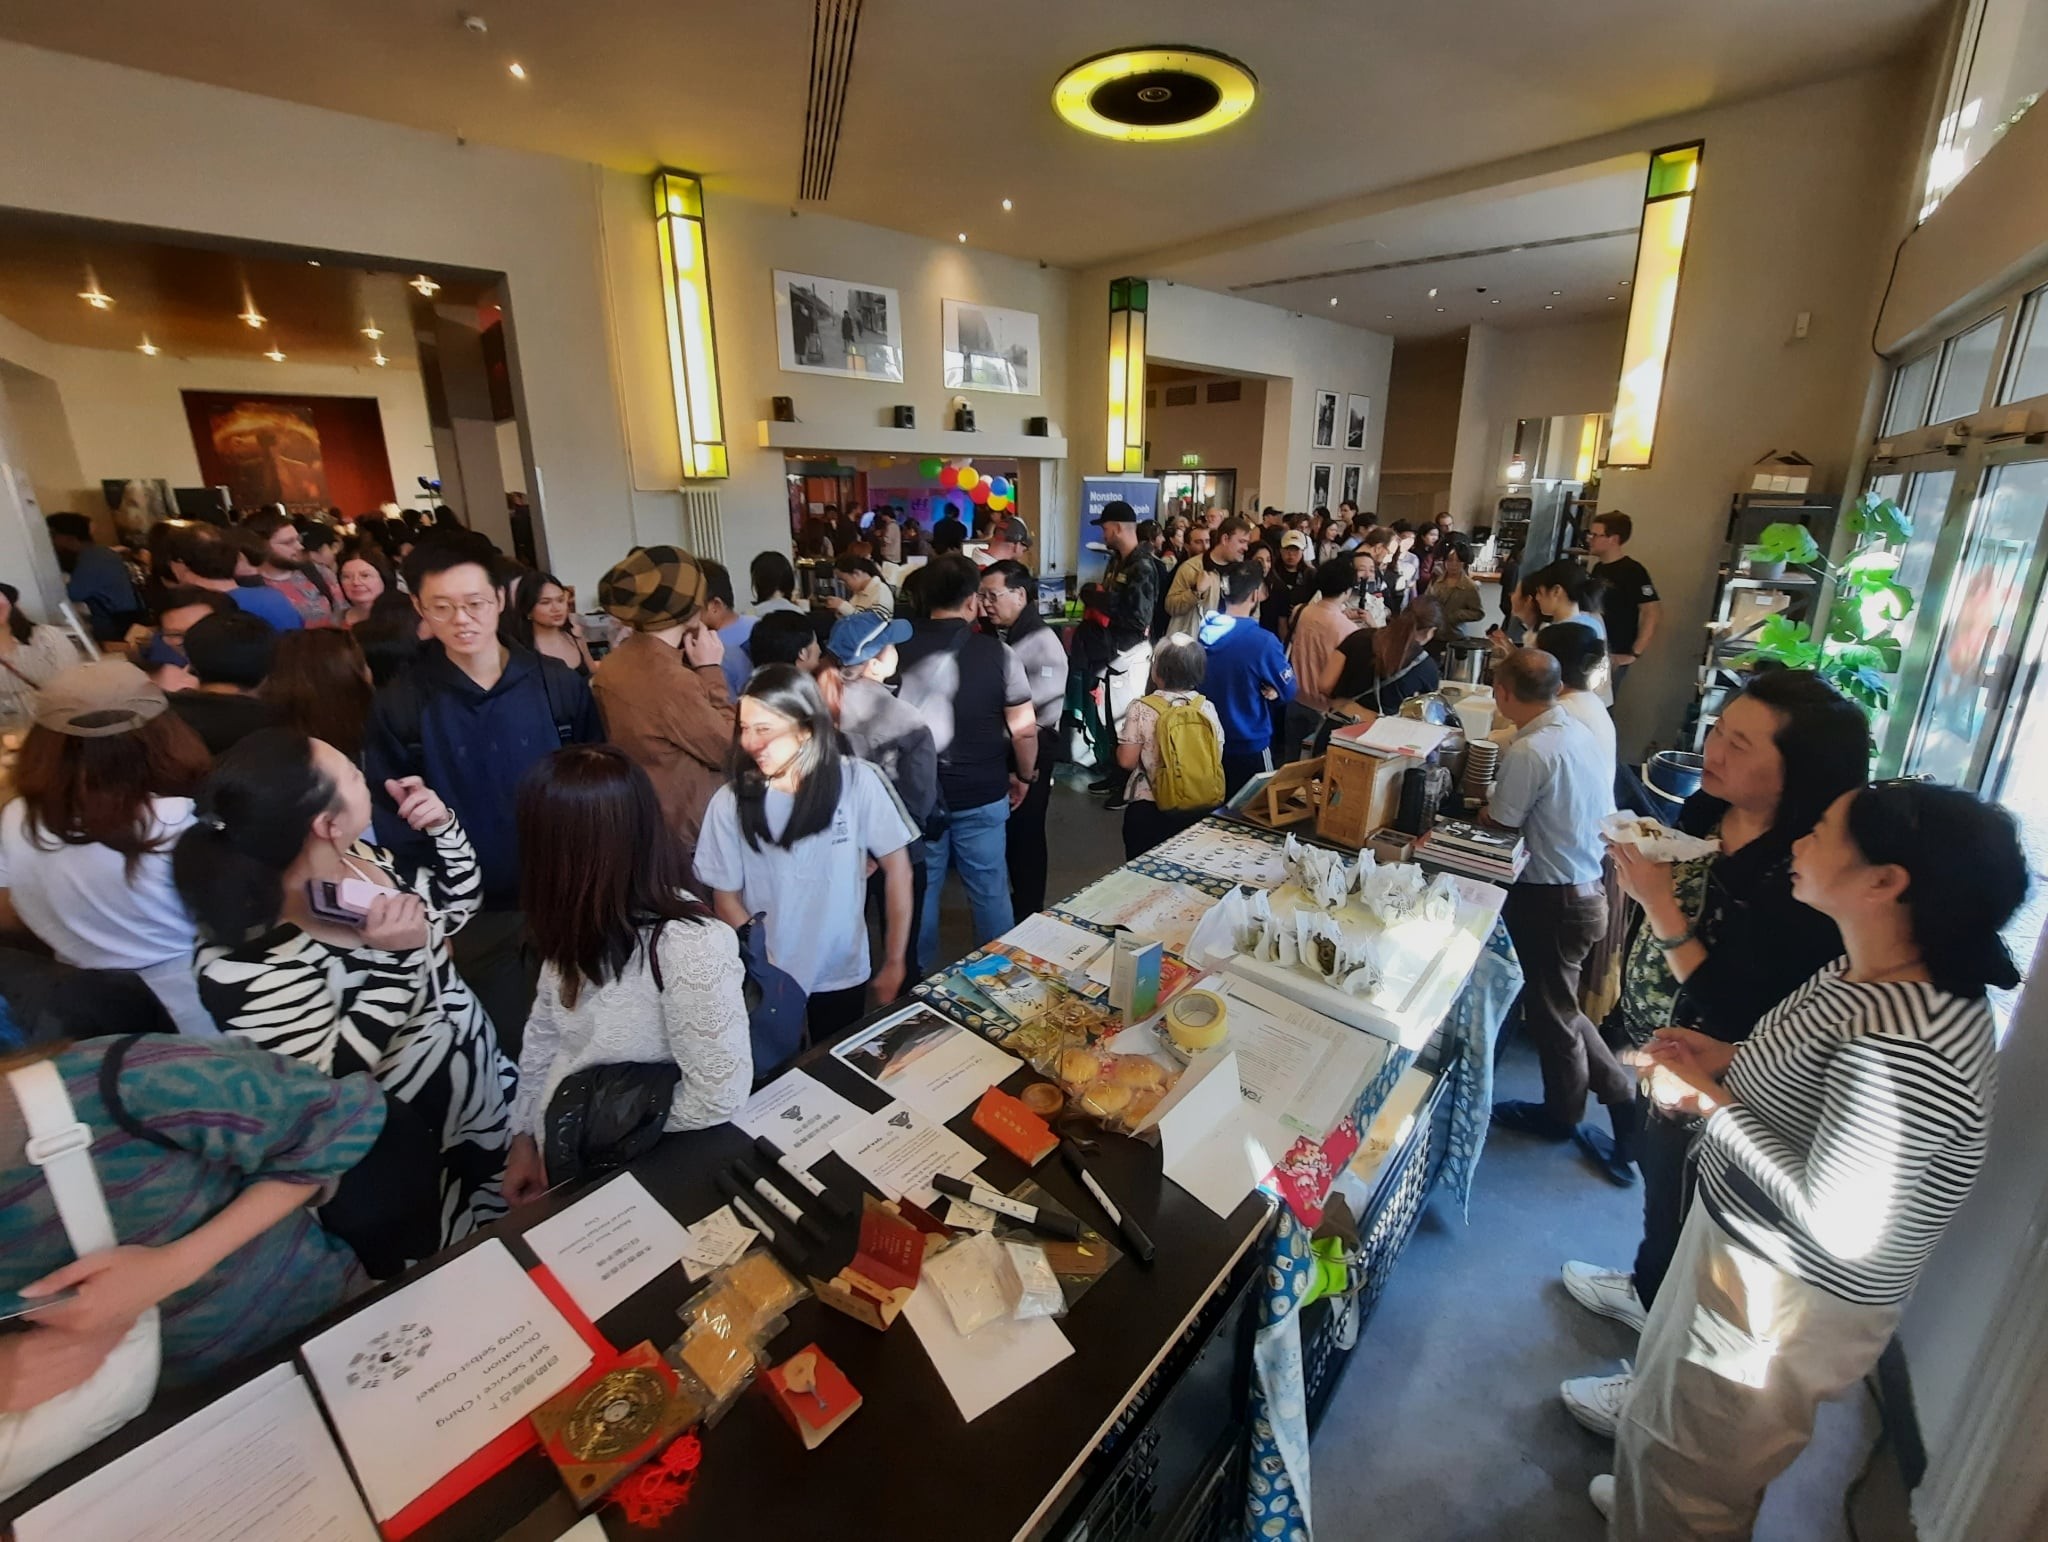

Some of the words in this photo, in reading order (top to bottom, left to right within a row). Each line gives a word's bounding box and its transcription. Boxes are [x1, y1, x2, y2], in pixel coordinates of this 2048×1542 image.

[497, 1324, 526, 1345] Ging
[482, 1331, 541, 1374] Divination
[435, 1400, 475, 1428] Ching
